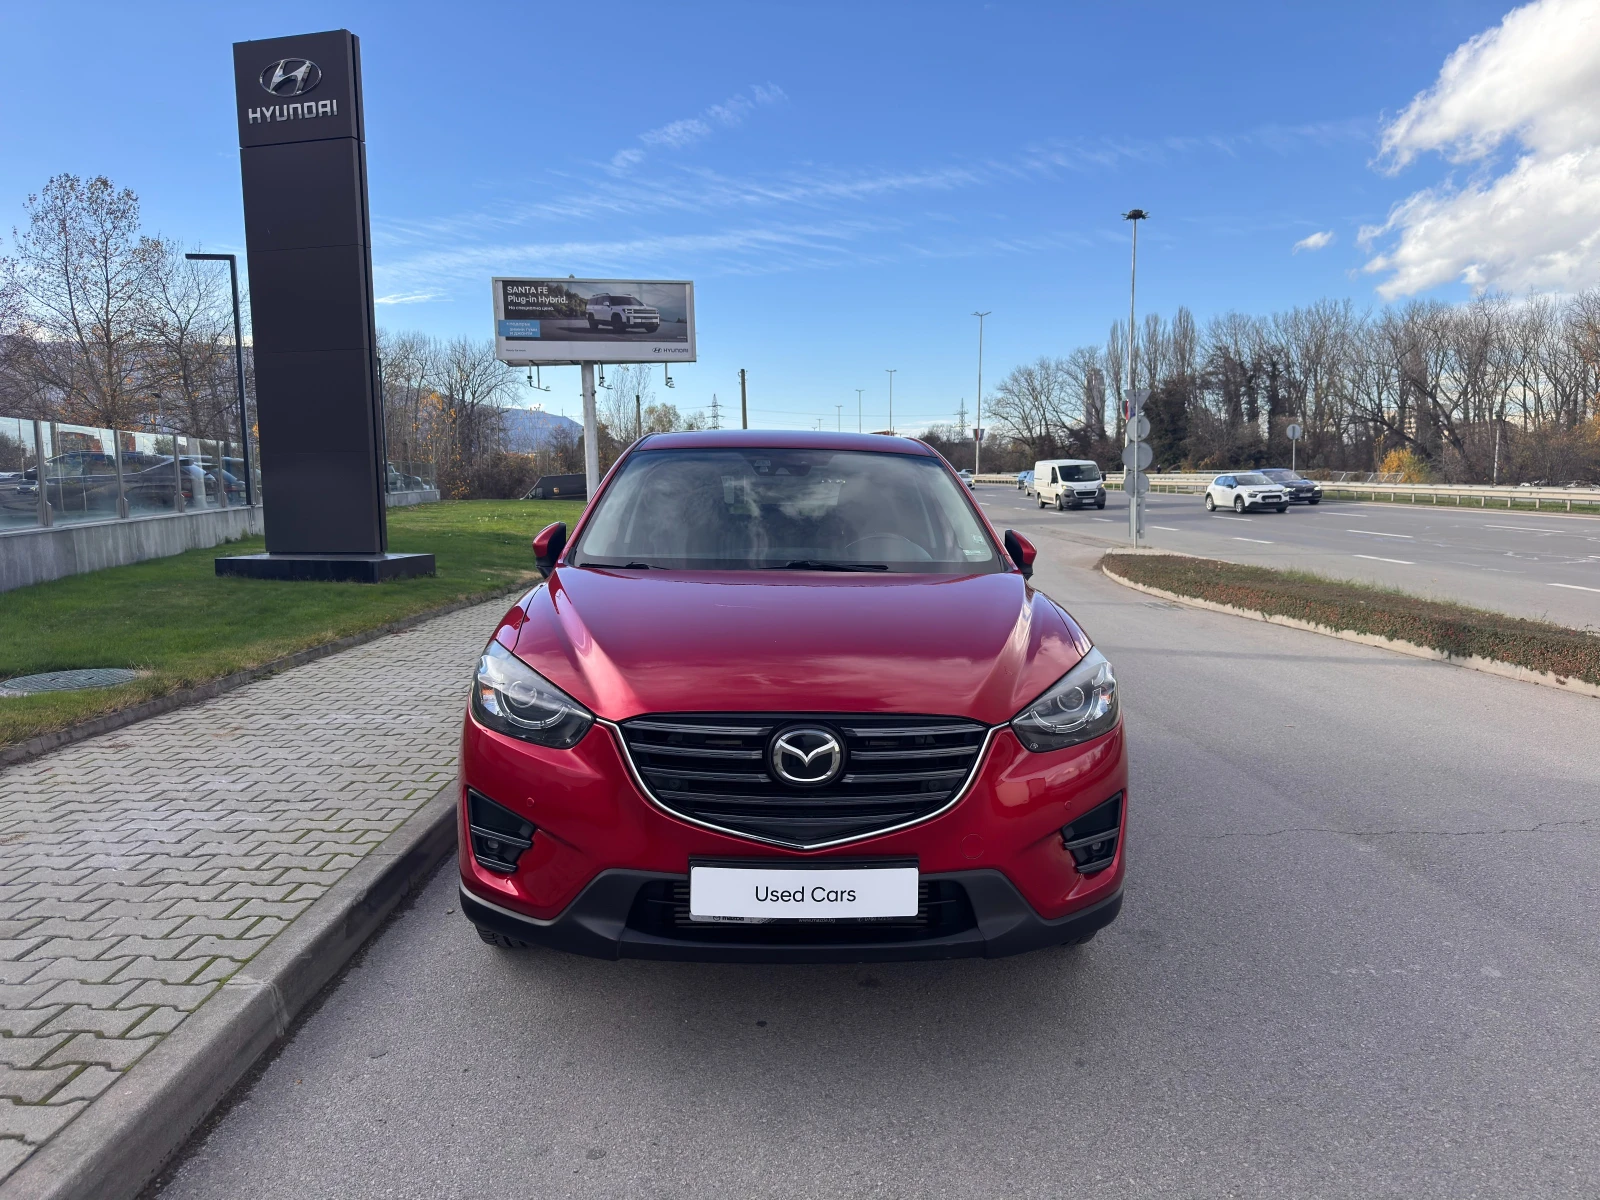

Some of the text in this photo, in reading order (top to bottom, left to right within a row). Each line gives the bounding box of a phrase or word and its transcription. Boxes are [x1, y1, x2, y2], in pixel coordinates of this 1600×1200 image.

[248, 99, 338, 125] HYUNDAI
[507, 286, 537, 294] SANTA
[507, 295, 569, 304] Plug-in Hybrid.
[755, 886, 857, 903] Used Cars
